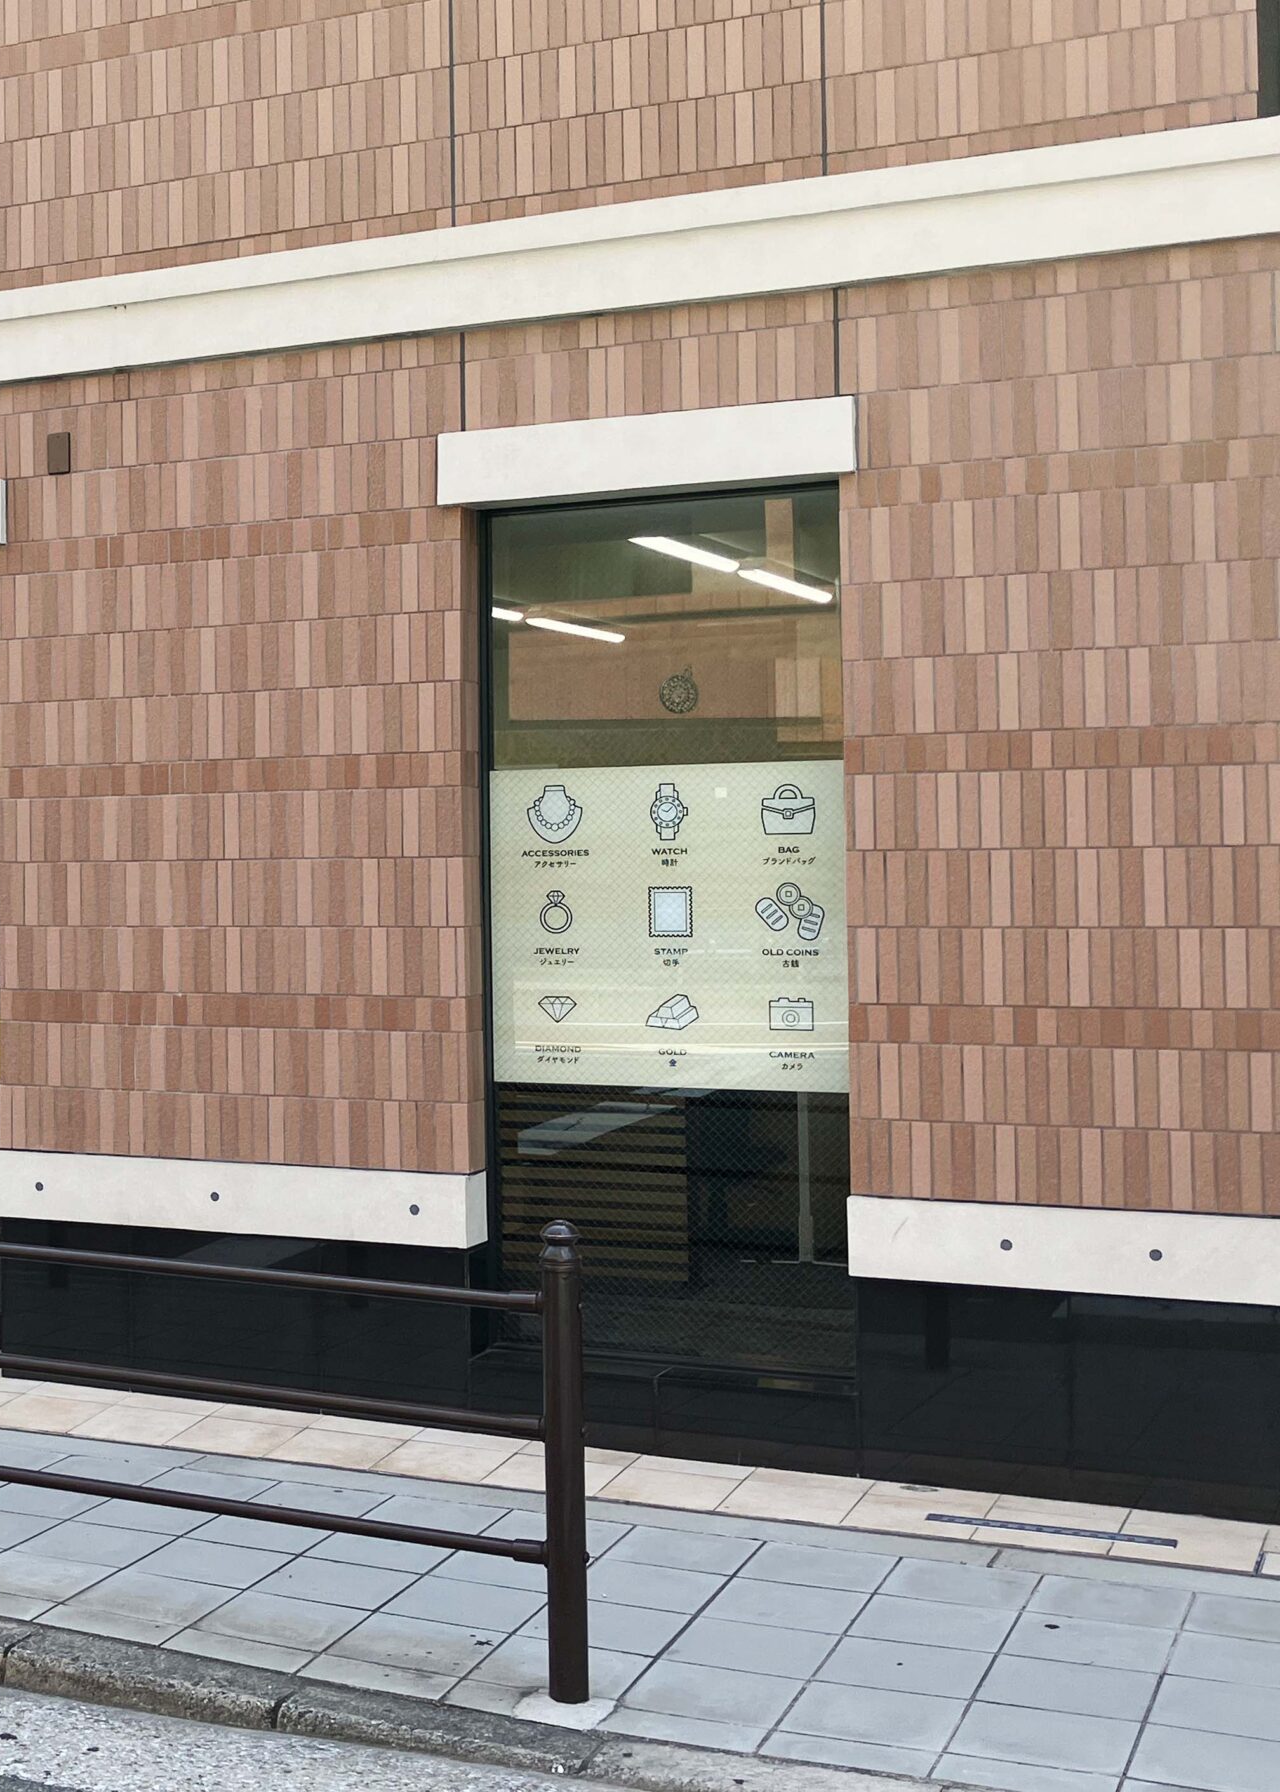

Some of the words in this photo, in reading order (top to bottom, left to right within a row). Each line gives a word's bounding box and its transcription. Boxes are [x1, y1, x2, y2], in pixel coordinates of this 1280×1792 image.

[521, 849, 590, 857] ACCESSORIES
[651, 847, 688, 855] WATCH
[777, 846, 800, 854] BAG
[534, 860, 577, 868] アクセサリー
[762, 856, 817, 865] ブランドバッグ
[533, 947, 580, 955] JEWELRY
[654, 947, 689, 956] STAMP
[761, 948, 784, 956] OLD
[785, 948, 820, 956] COINS
[540, 957, 575, 966] ジュエリー
[535, 1045, 582, 1053] DIAMOND
[658, 1048, 688, 1056] GOLD
[768, 1050, 816, 1060] CAMERA
[537, 1055, 580, 1064] ダイヤモンド
[781, 1062, 803, 1071] カメラ
